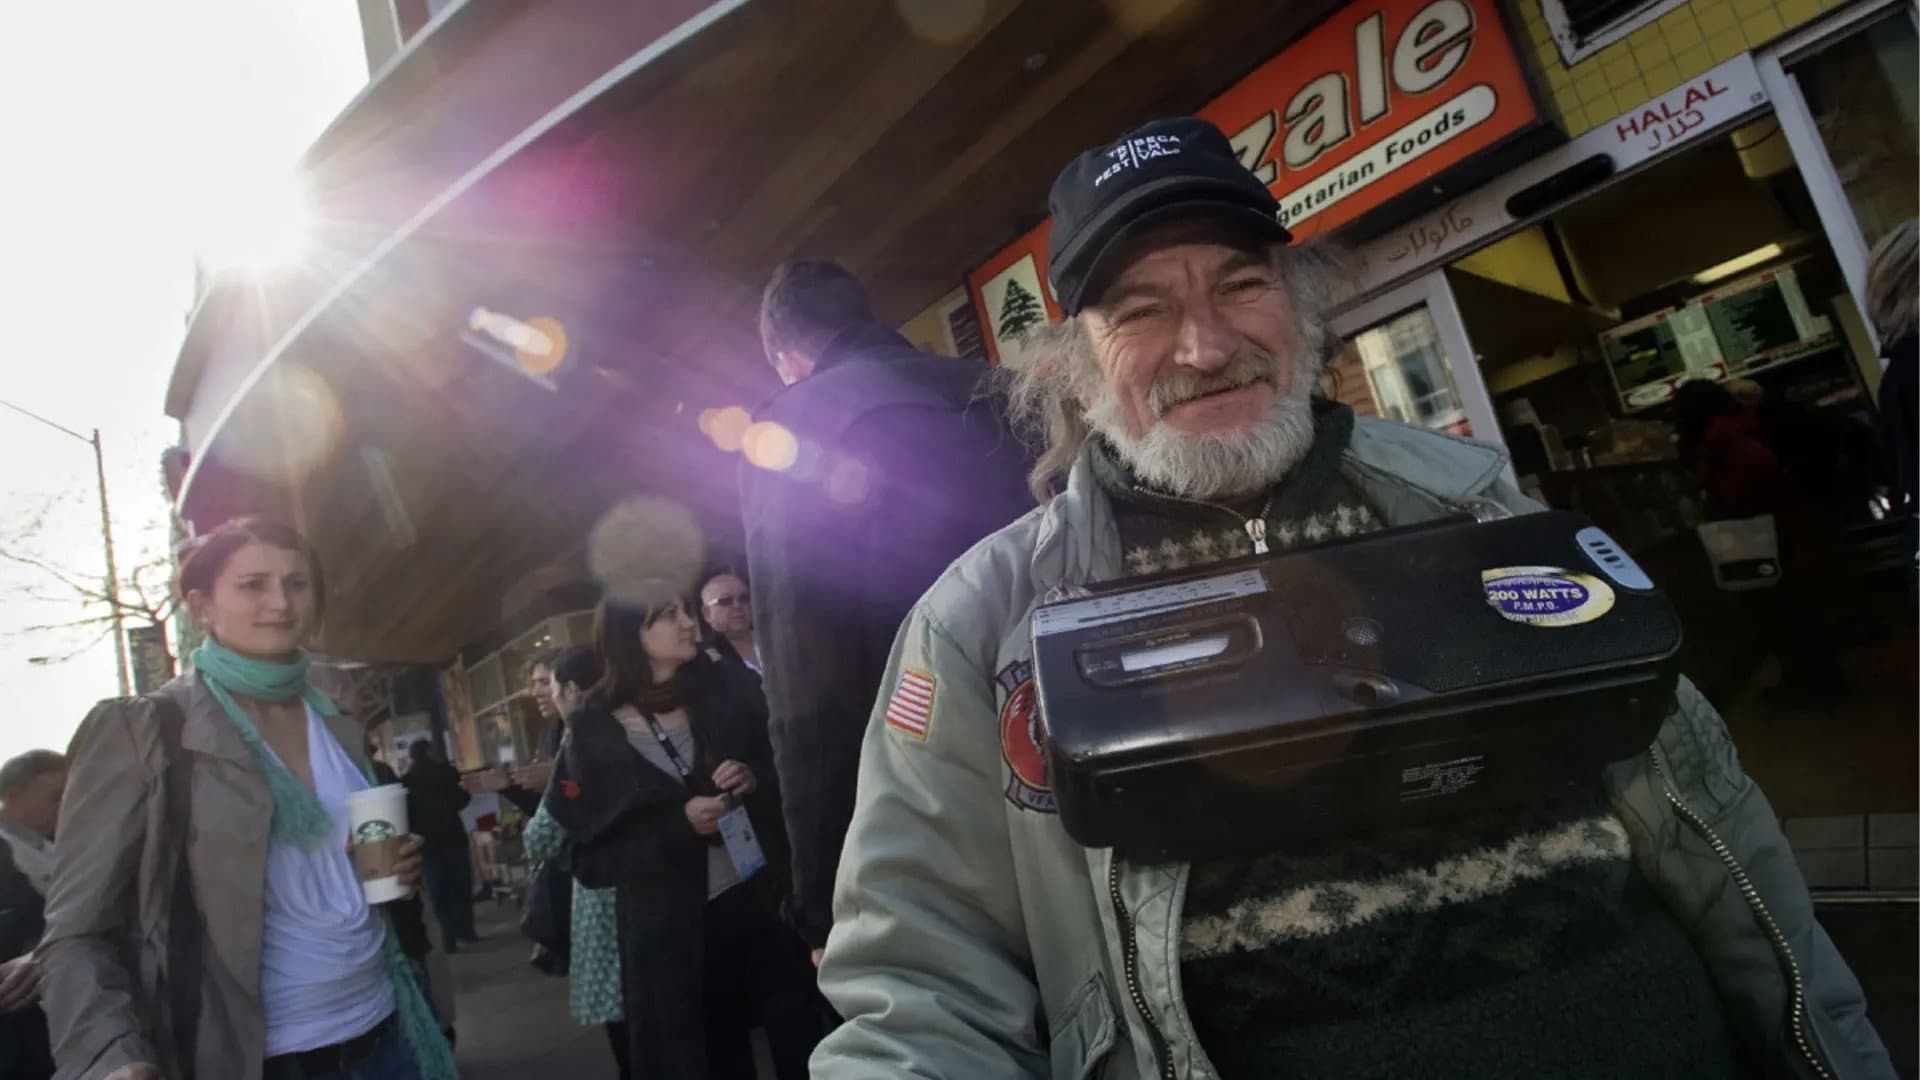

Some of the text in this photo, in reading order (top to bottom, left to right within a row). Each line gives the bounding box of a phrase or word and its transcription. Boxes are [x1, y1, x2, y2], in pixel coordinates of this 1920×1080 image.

[1385, 107, 1466, 164] Foods
[1616, 79, 1729, 142] HALAL
[1488, 587, 1583, 601] 200 WATTS
